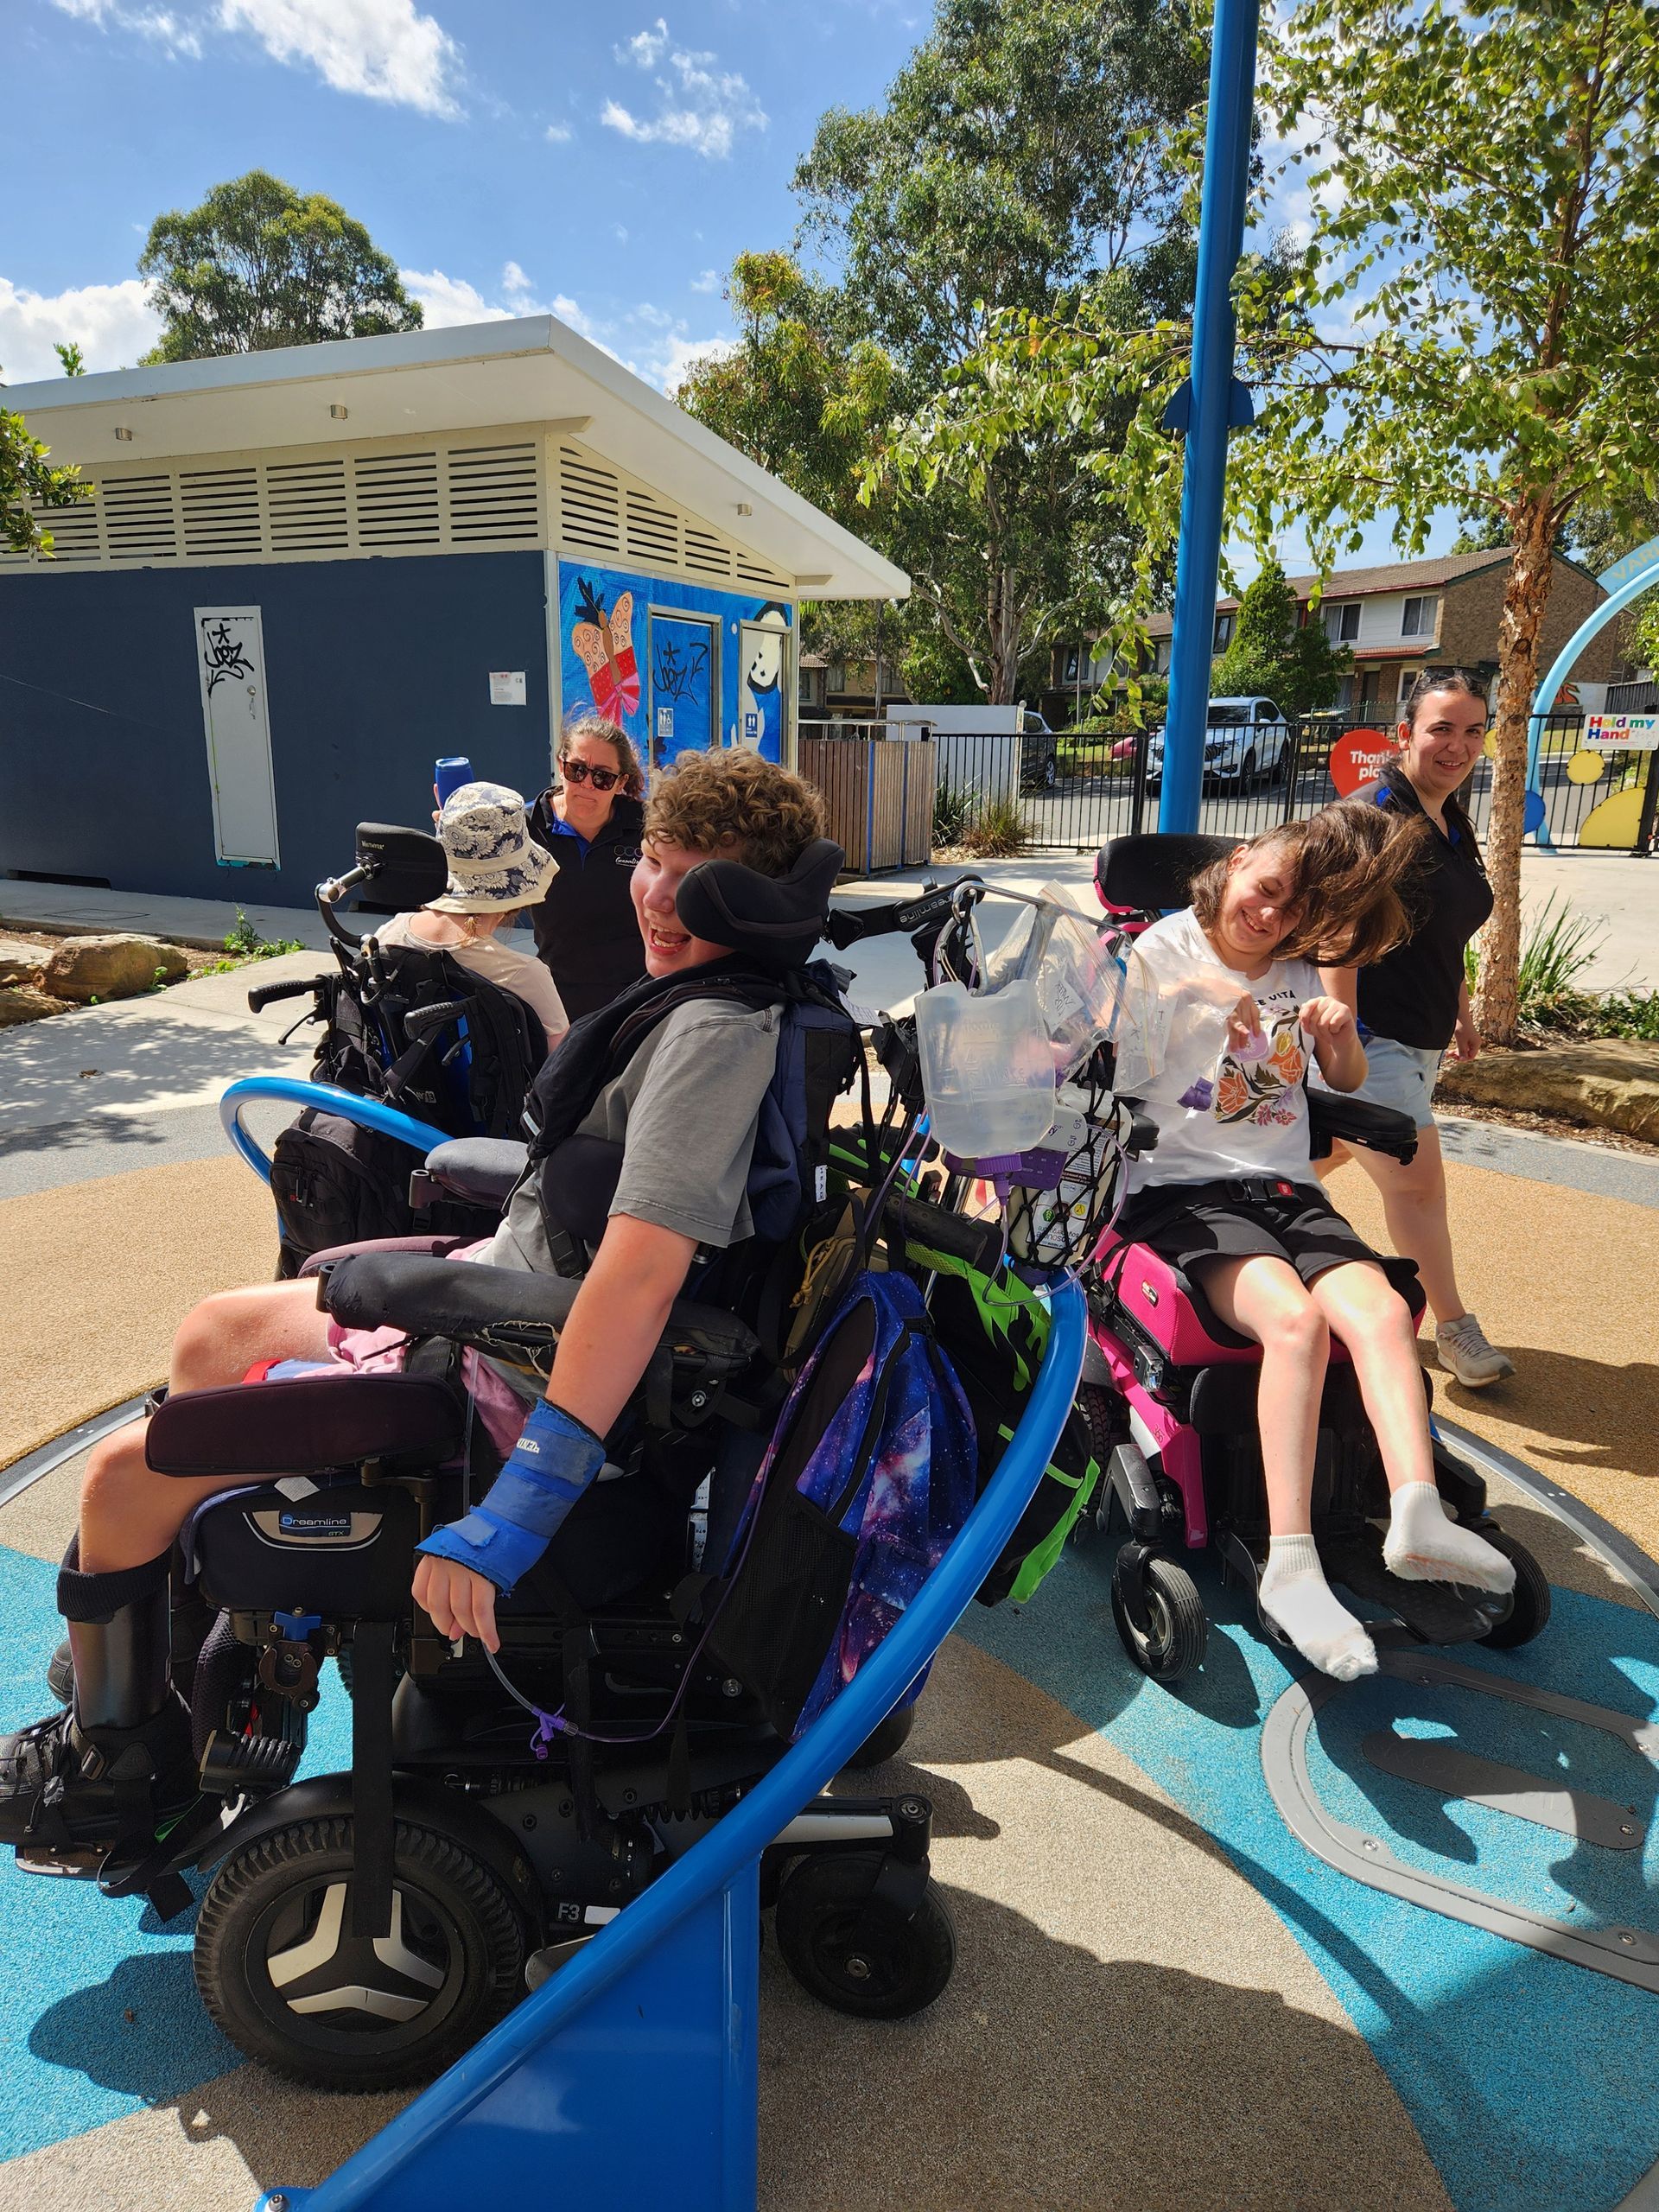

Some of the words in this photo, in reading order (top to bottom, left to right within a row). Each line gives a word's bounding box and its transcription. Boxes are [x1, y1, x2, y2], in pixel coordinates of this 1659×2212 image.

[1589, 716, 1626, 728] Hold
[1629, 719, 1656, 729] my
[1587, 728, 1630, 740] Hand
[1358, 765, 1380, 781] pla
[1268, 989, 1296, 1001] VITA
[283, 1516, 346, 1525] Dreamline
[557, 1903, 580, 1920] F3
